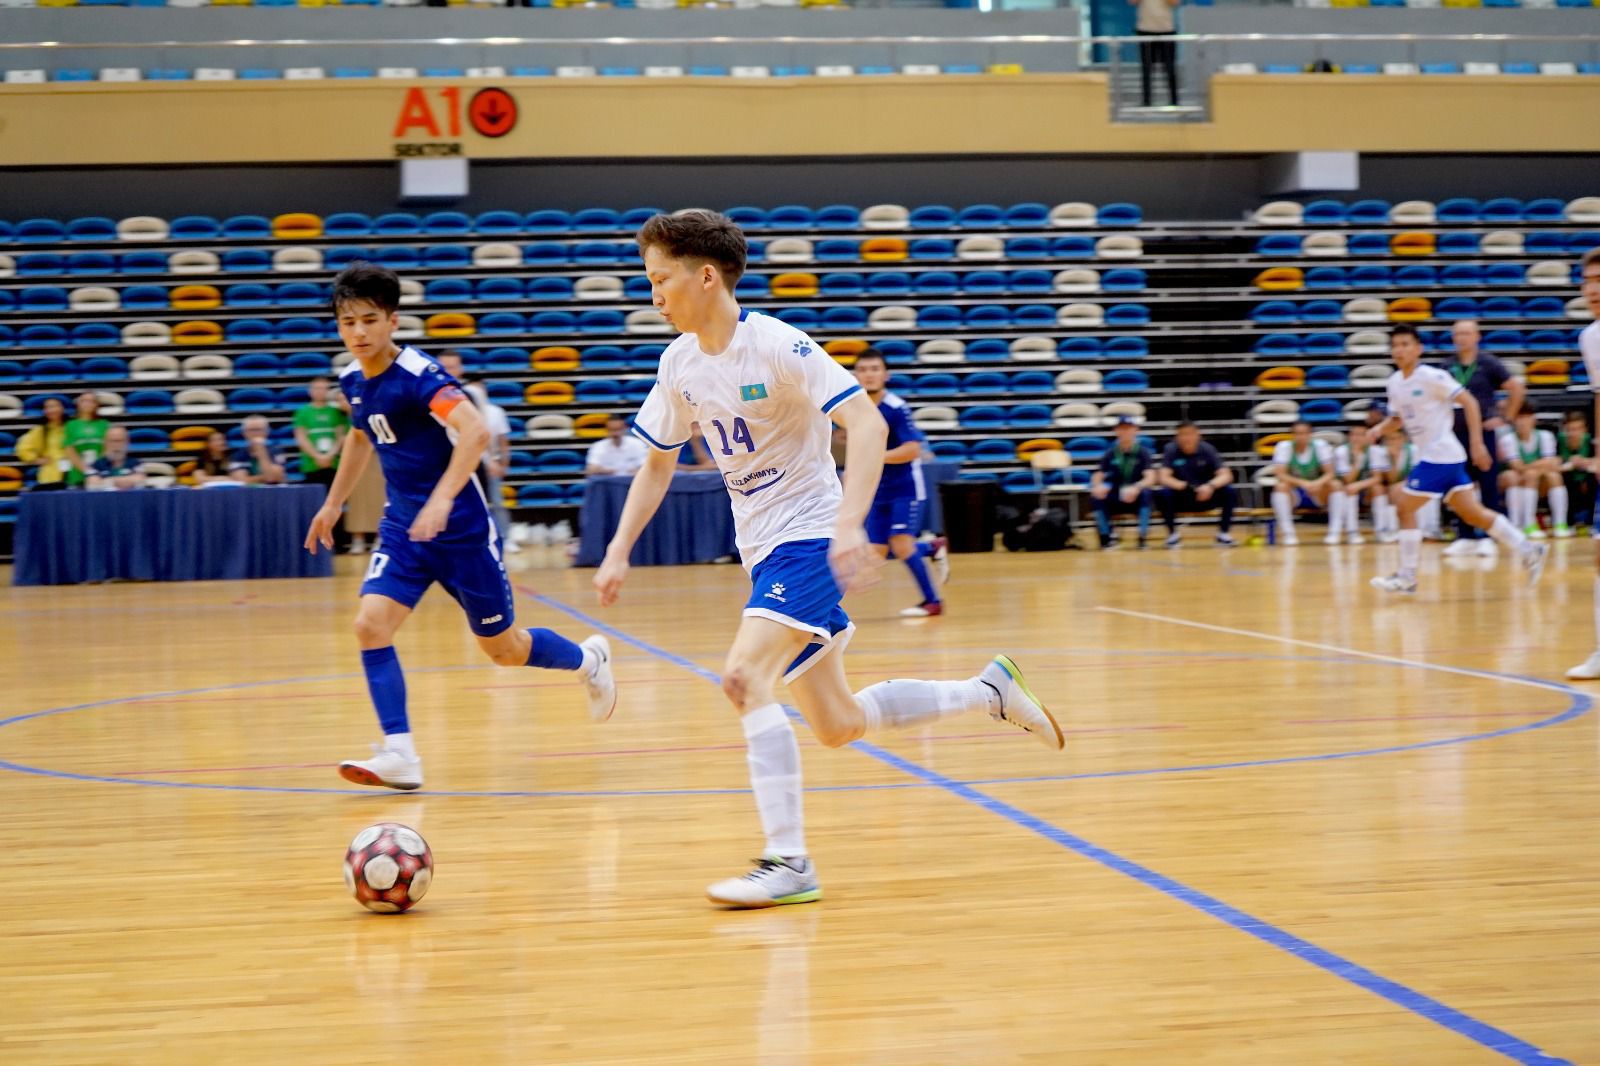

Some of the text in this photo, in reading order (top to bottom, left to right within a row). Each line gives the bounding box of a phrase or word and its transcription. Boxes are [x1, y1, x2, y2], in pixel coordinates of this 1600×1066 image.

[393, 86, 462, 137] A1
[394, 143, 462, 157] SEKTOR
[368, 413, 397, 444] 10
[712, 416, 755, 455] 14
